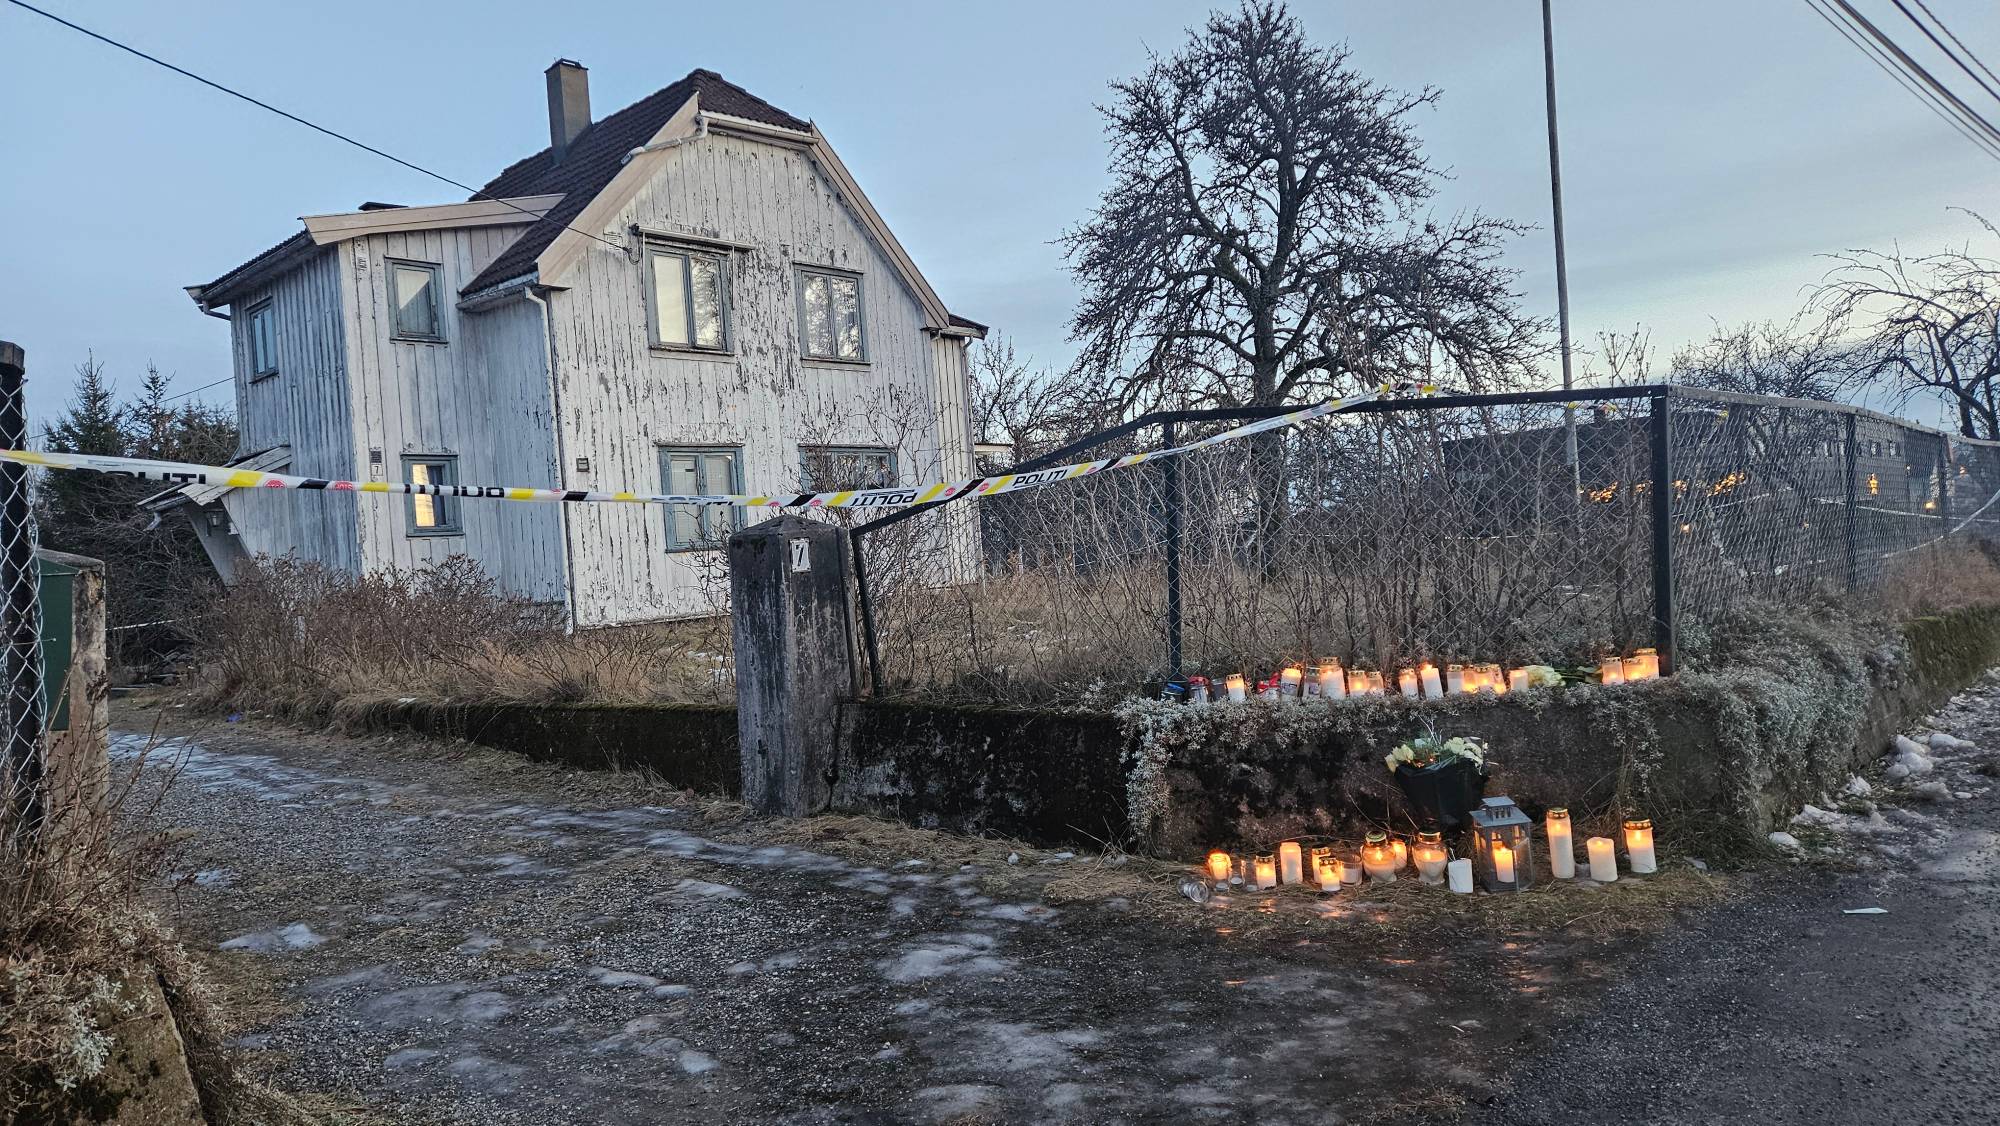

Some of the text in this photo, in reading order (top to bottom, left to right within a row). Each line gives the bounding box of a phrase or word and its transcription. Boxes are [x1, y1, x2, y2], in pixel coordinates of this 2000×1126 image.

[1012, 470, 1068, 487] POLITI
[850, 492, 918, 507] POLITI
[795, 544, 804, 567] 7
